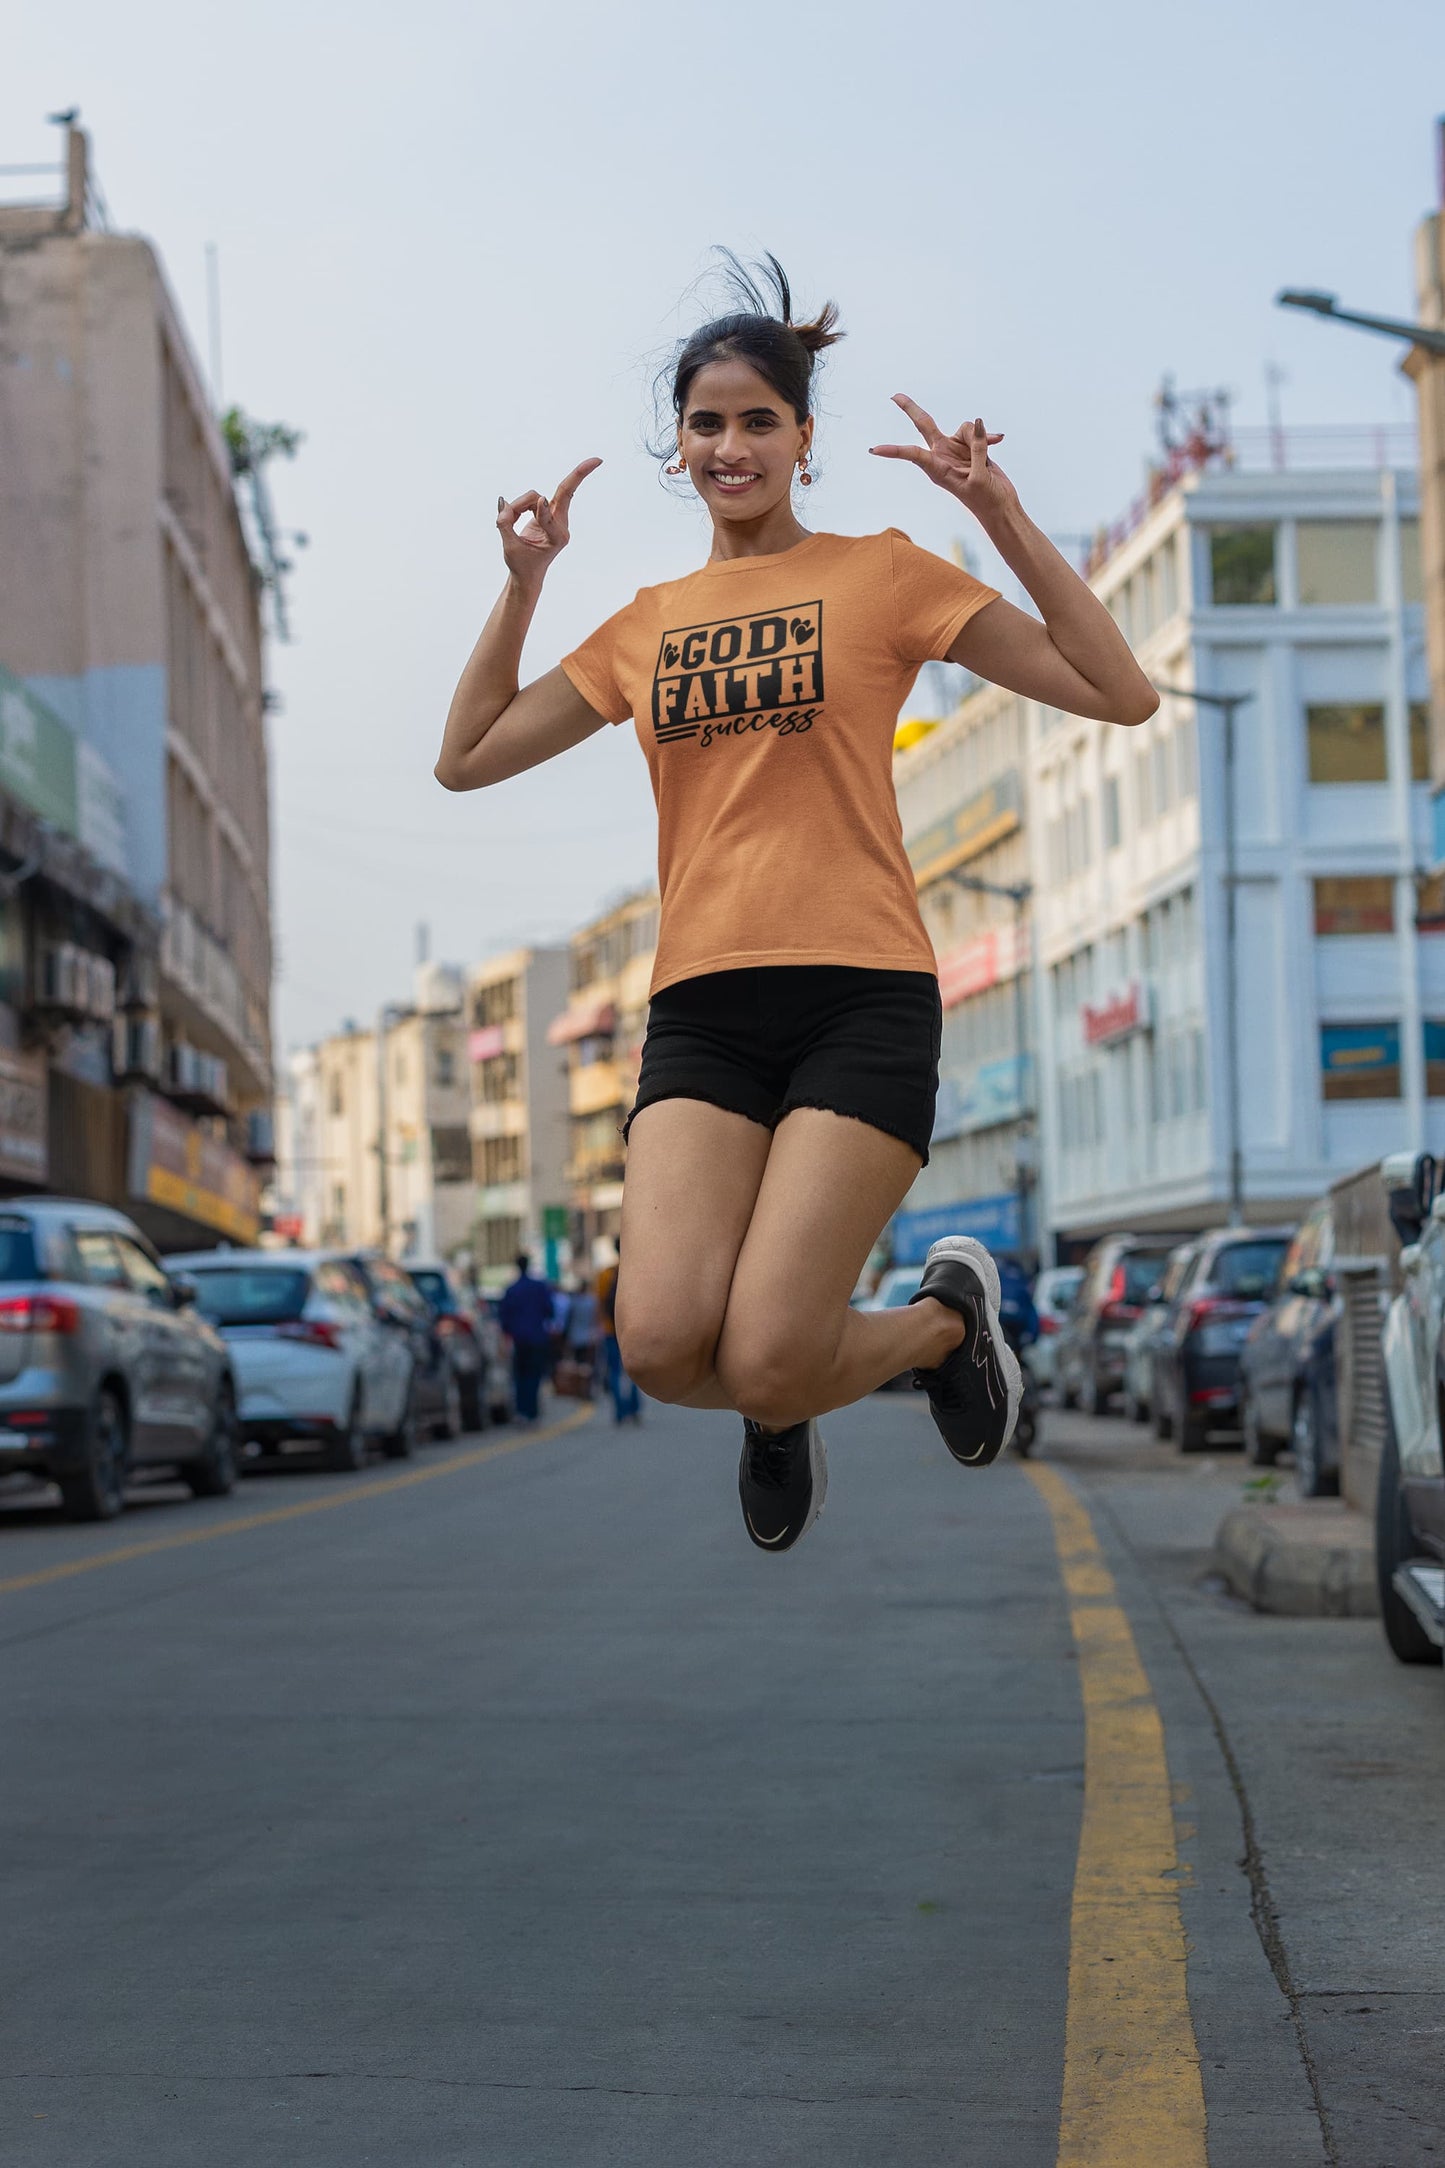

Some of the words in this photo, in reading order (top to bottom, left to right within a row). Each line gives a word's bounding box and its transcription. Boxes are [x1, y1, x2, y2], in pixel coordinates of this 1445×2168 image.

[680, 616, 787, 670] GOD
[658, 654, 816, 726] FAITH
[700, 708, 824, 747] success
